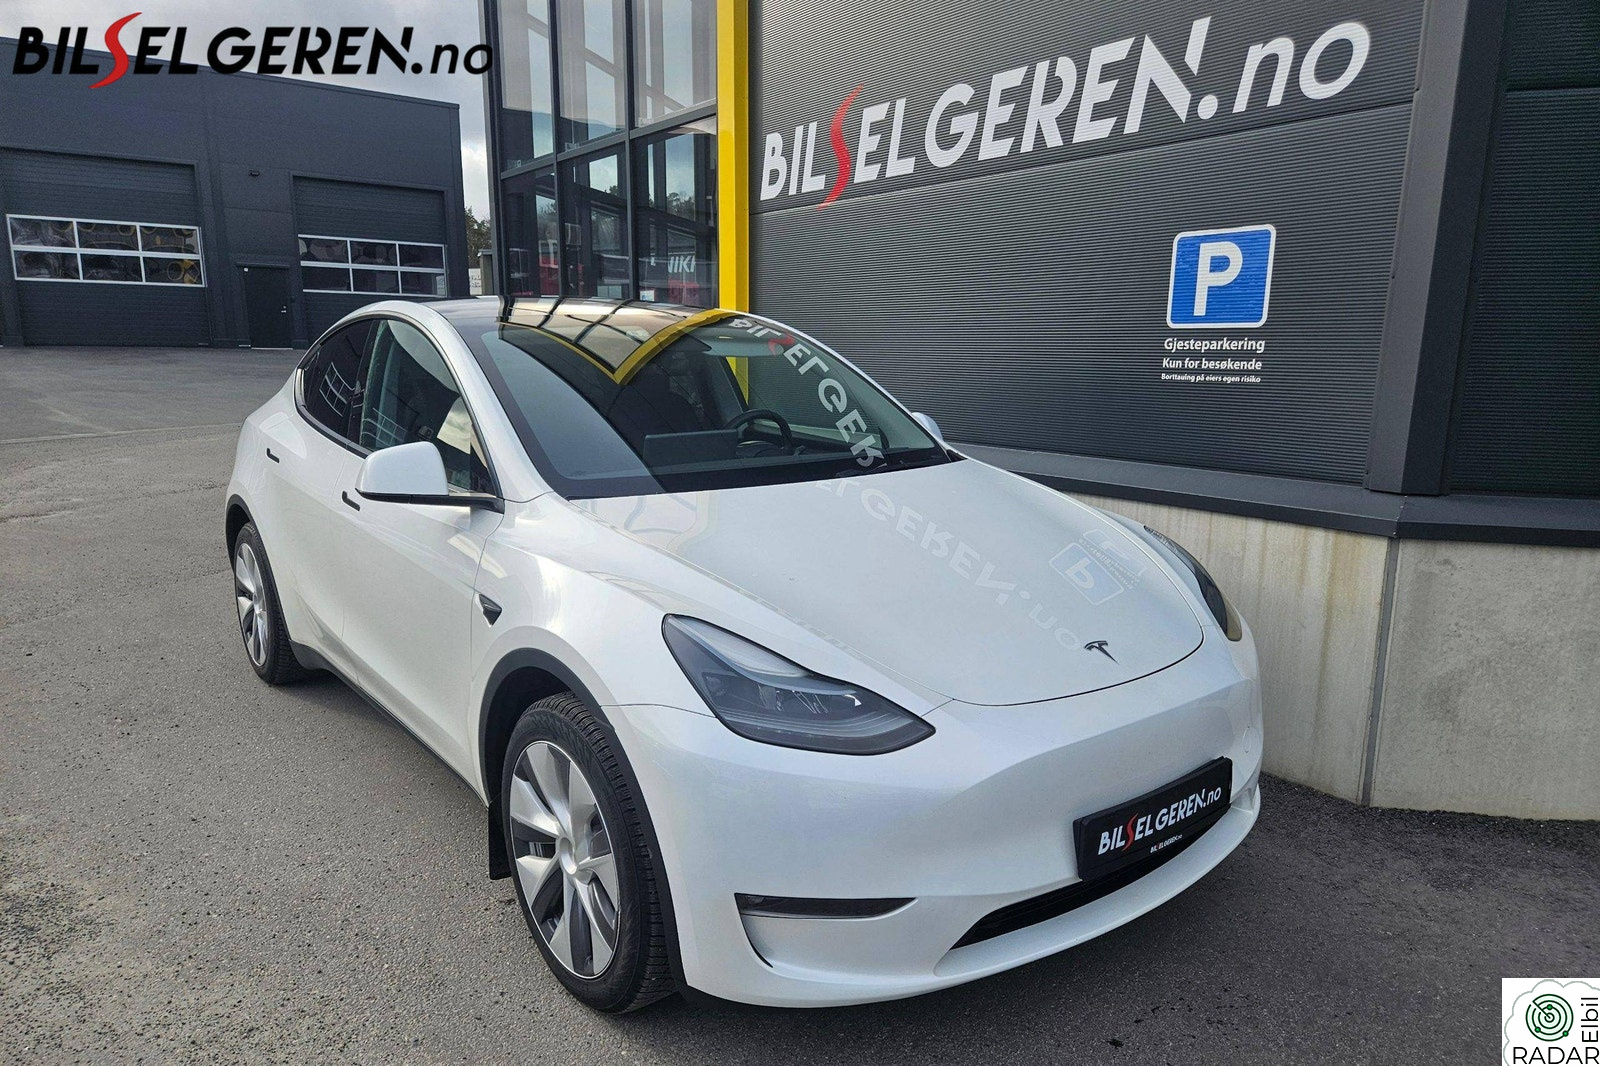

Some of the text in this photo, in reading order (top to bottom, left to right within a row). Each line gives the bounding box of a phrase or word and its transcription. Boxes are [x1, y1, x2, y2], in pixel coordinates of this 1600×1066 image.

[1193, 241, 1243, 316] P
[1164, 337, 1266, 353] Gjesteparkering
[1162, 357, 1262, 370] Kun for besøkende
[1161, 373, 1195, 382] Borttauing
[1196, 374, 1204, 382] på
[1206, 374, 1221, 382] eiers
[1241, 375, 1261, 383] risiko
